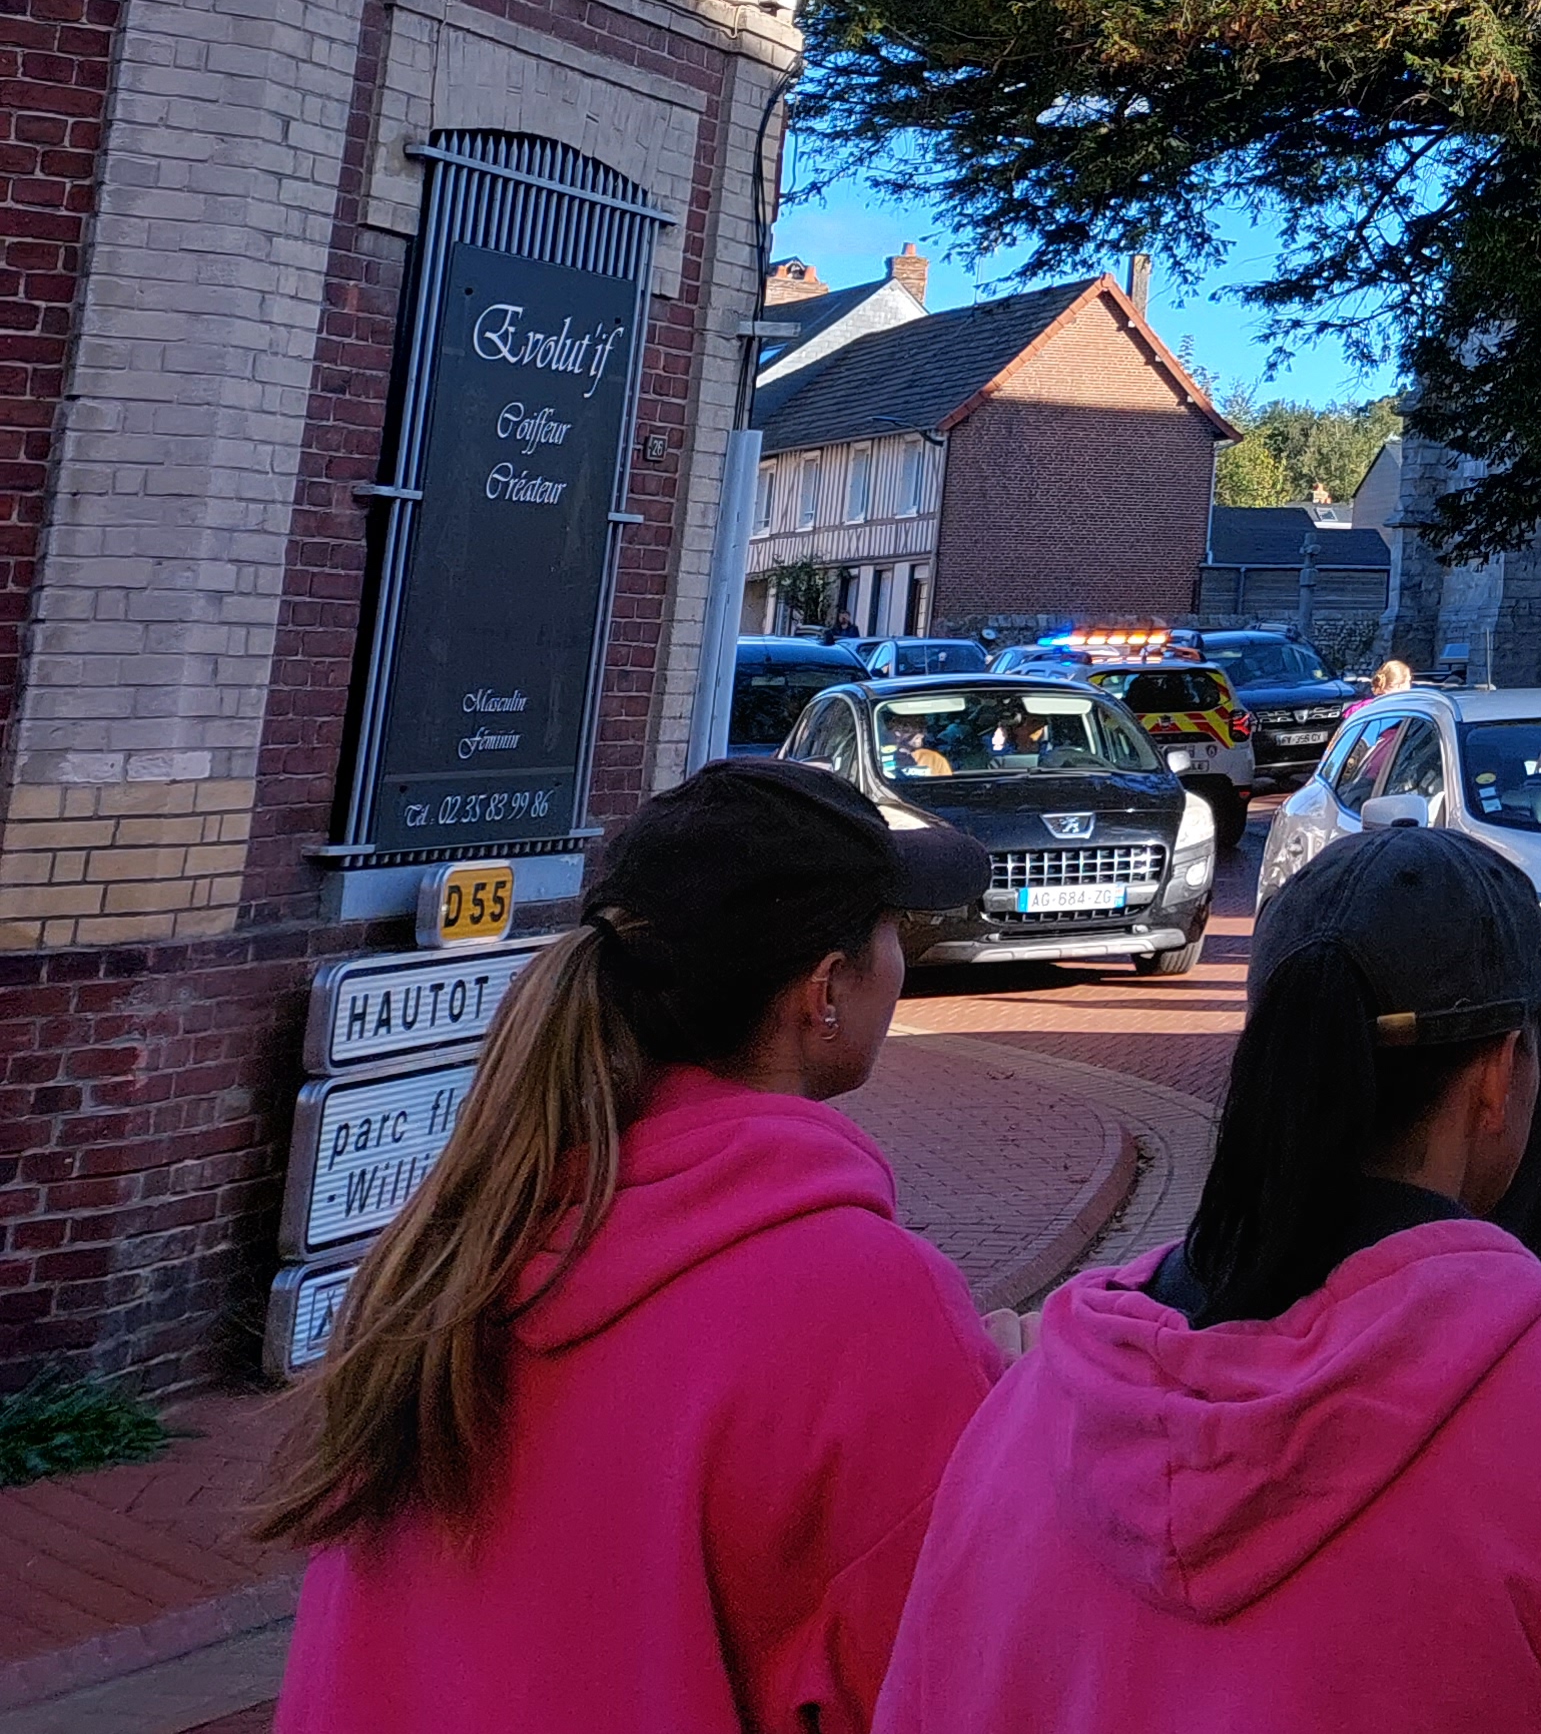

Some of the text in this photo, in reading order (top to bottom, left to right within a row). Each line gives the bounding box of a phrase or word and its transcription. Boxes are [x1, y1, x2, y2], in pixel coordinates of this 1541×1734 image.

[496, 402, 572, 455] Coiffeur
[652, 439, 664, 456] 26
[486, 462, 567, 505] Créateur
[462, 688, 529, 713] Masculin
[458, 726, 522, 759] Féminin
[438, 795, 461, 825] 02
[460, 794, 488, 823] 35
[485, 793, 508, 821] 83
[507, 791, 530, 820] 99
[531, 789, 555, 818] 86
[444, 879, 509, 929] D 55
[346, 975, 490, 1042] HAUTOT
[328, 1110, 408, 1172] parc
